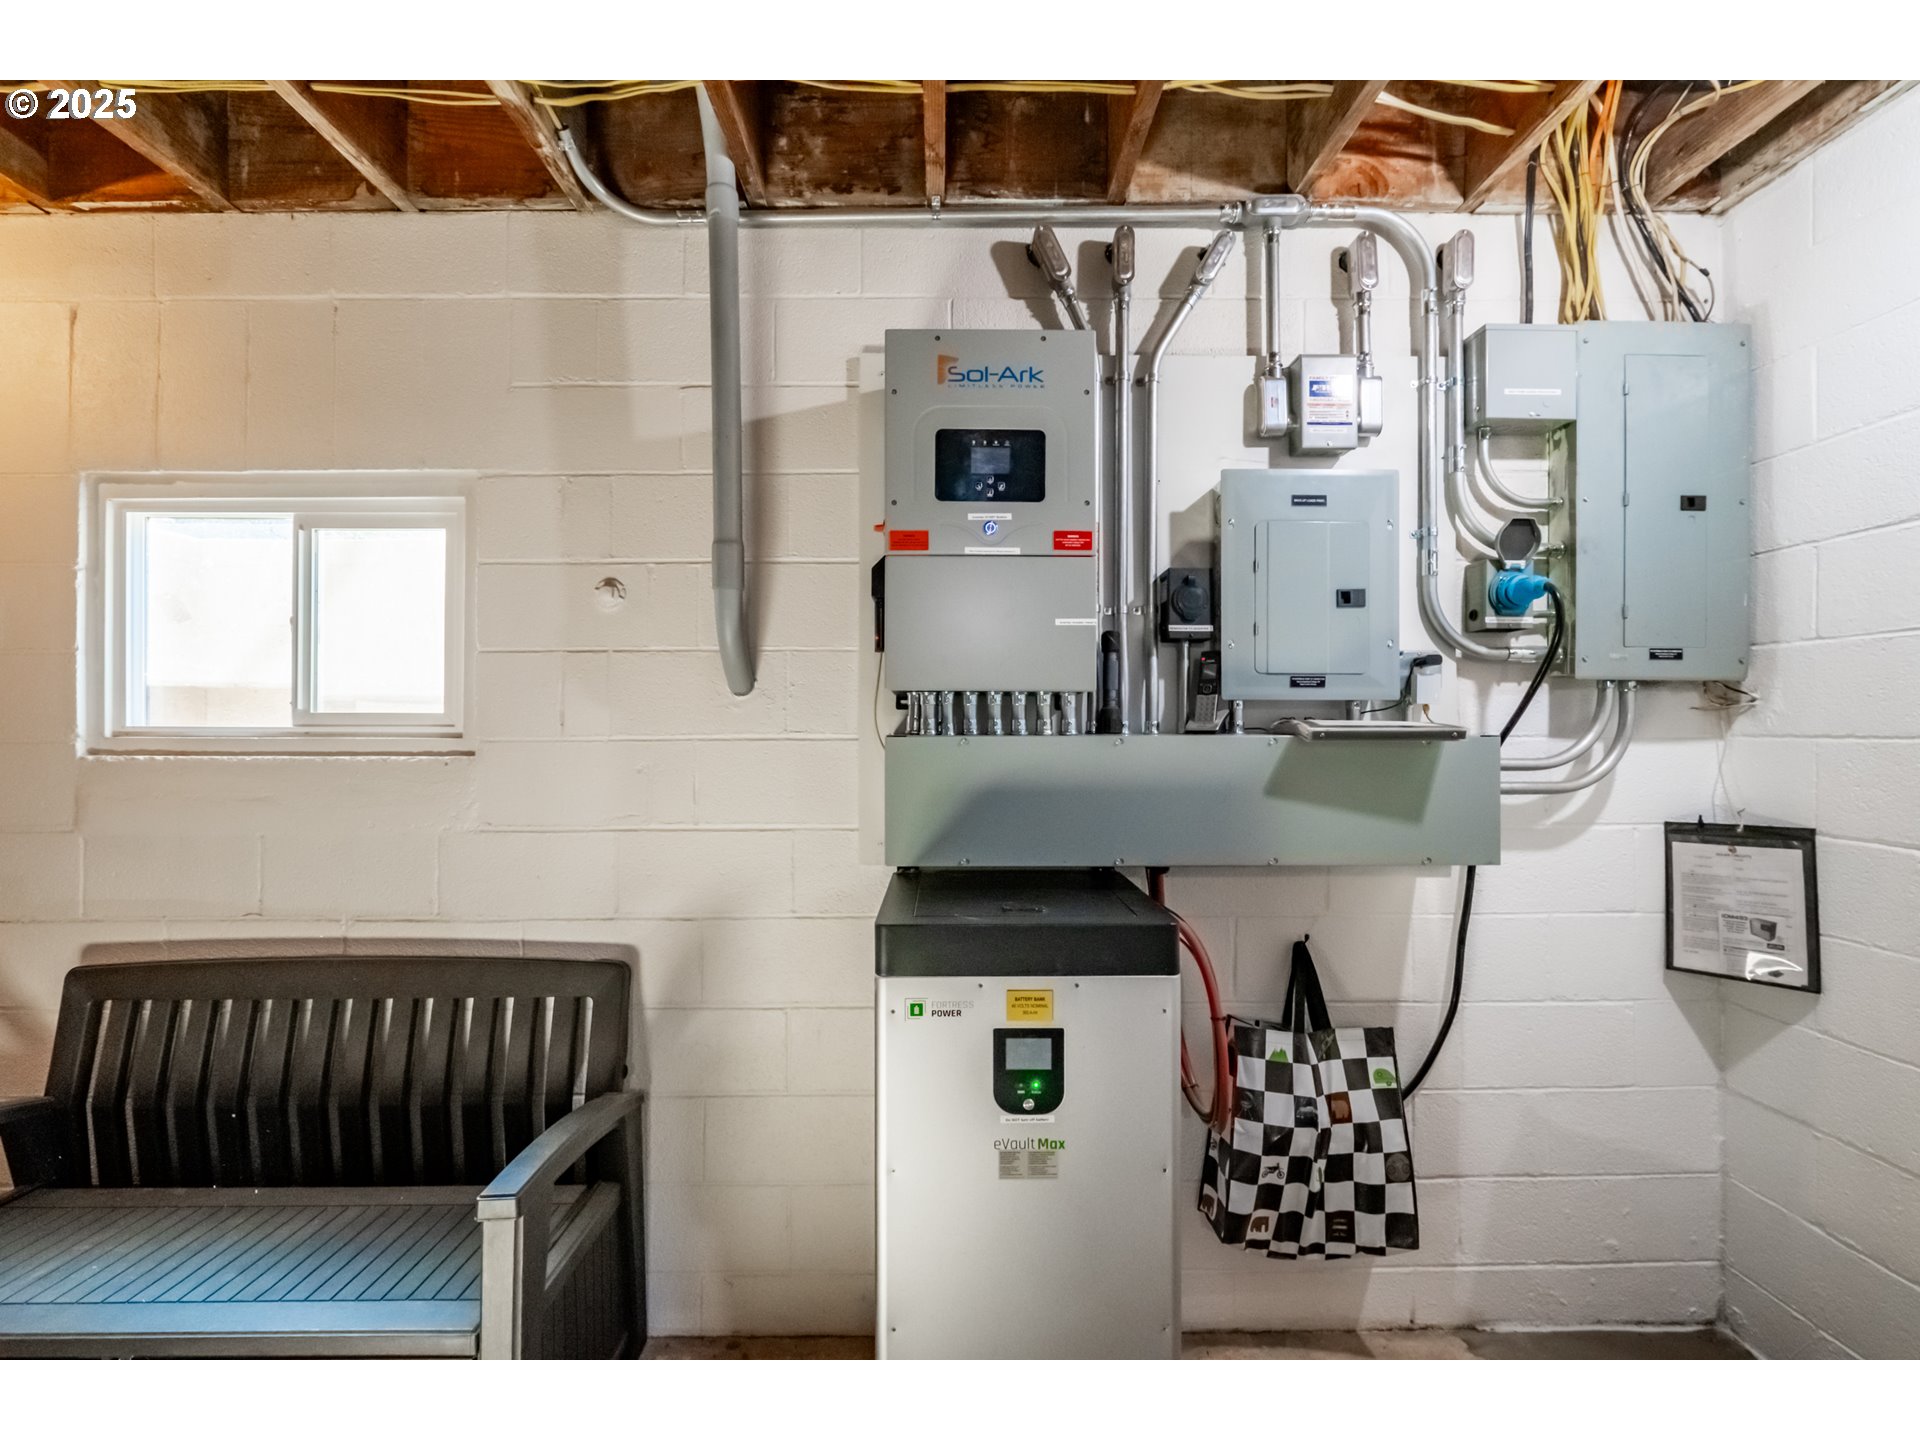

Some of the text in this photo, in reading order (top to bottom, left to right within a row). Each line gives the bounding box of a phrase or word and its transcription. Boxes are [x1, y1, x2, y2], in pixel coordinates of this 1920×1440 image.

[947, 366, 1044, 383] Sol-Ark
[931, 1000, 974, 1009] FORTRESS
[931, 1009, 962, 1017] POWER
[993, 1137, 1065, 1150] eVault Max
